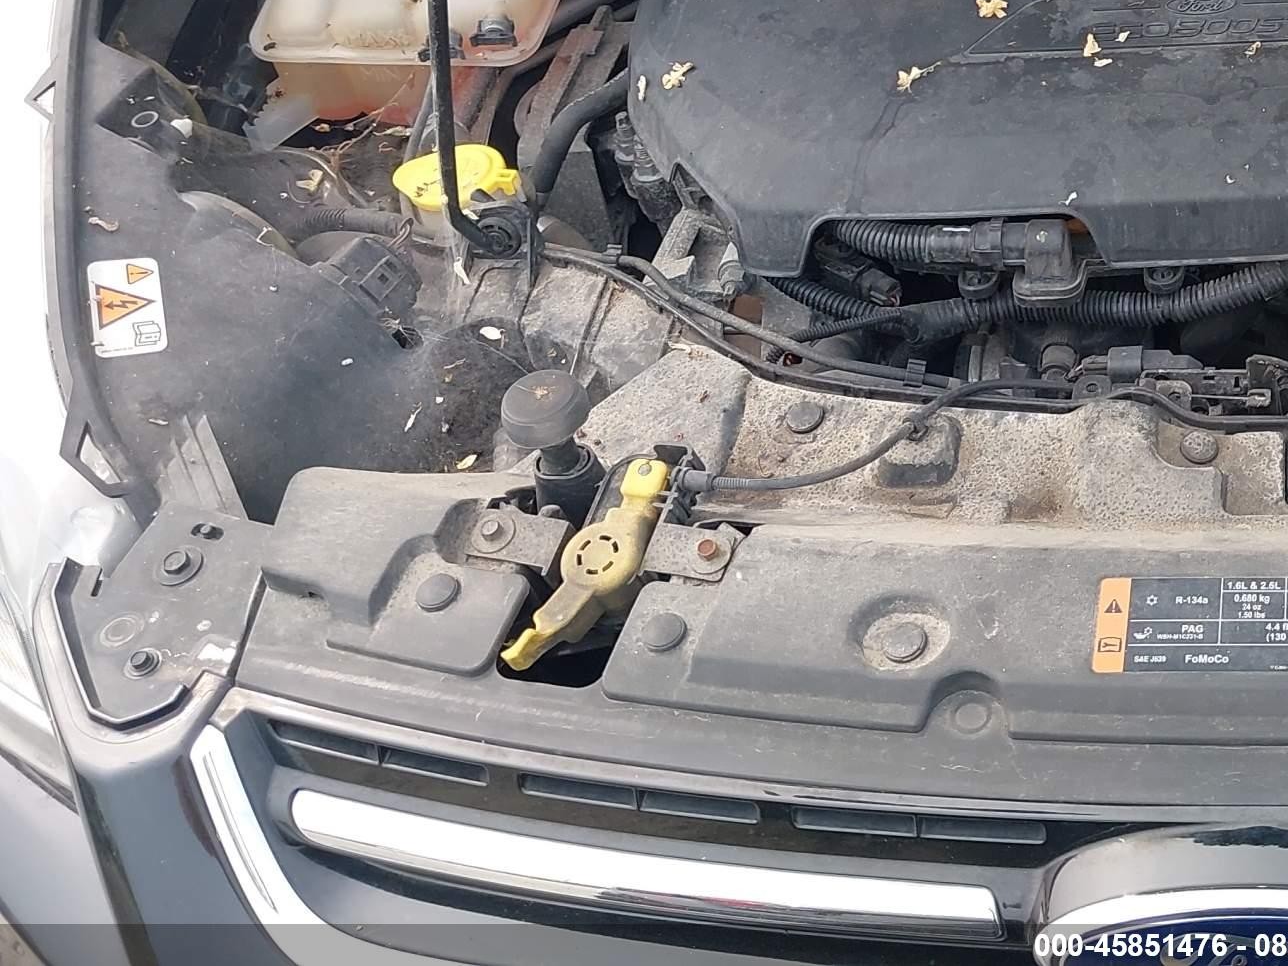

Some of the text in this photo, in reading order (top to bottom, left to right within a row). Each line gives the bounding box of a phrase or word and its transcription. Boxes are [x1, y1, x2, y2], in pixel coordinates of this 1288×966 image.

[1227, 581, 1281, 589] 1.6L & 2.5L
[1176, 596, 1208, 604] R-134a
[1234, 594, 1270, 604] 0.680 kg
[1181, 625, 1204, 633] PAG
[1265, 623, 1280, 631] 4.4
[1282, 623, 1288, 631] fl
[1266, 633, 1287, 642] (130
[1185, 654, 1229, 663] FoMoCo
